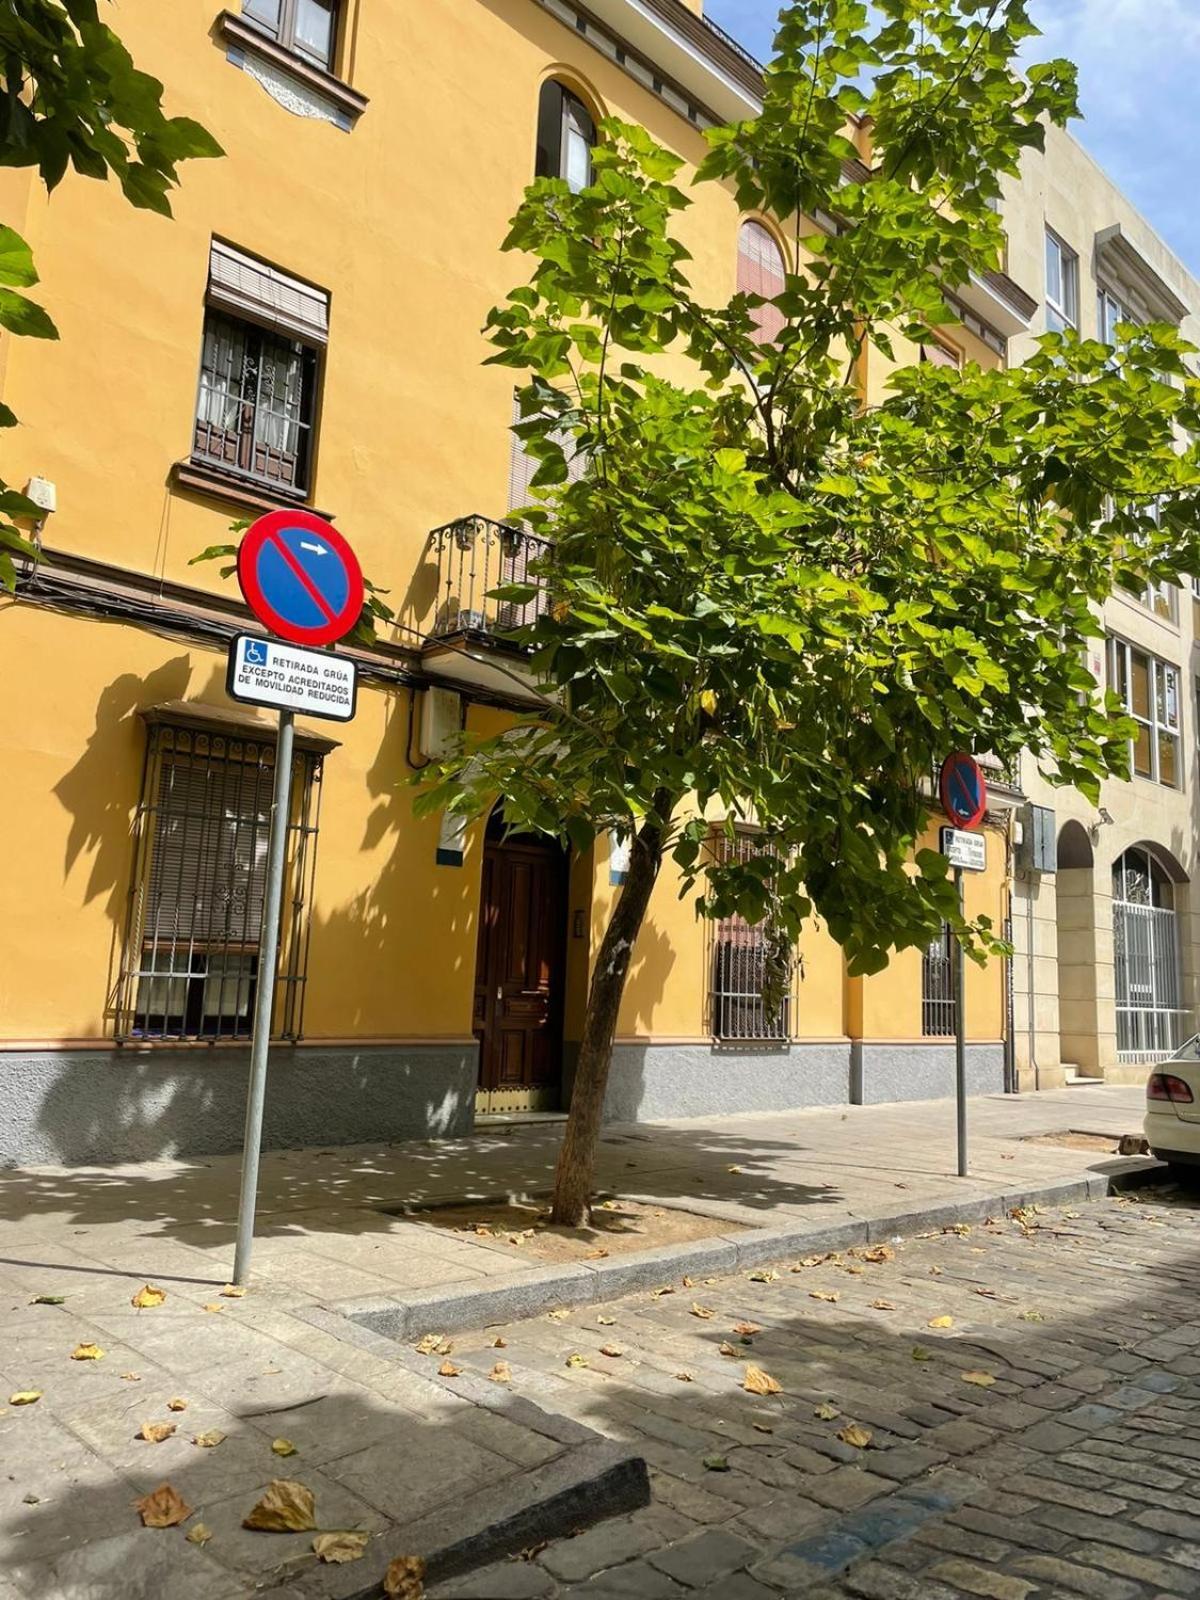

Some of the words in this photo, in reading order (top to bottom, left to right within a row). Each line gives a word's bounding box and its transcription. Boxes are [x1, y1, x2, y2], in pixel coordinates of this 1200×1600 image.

[242, 665, 285, 680] EXCEPTO
[288, 675, 349, 695] ACREDITADOS
[272, 657, 319, 675] RETIRADA
[323, 669, 348, 681] GRÚA
[238, 674, 251, 684] DE
[255, 678, 304, 696] MOVILIDAD
[307, 689, 350, 705] REDUCIDA
